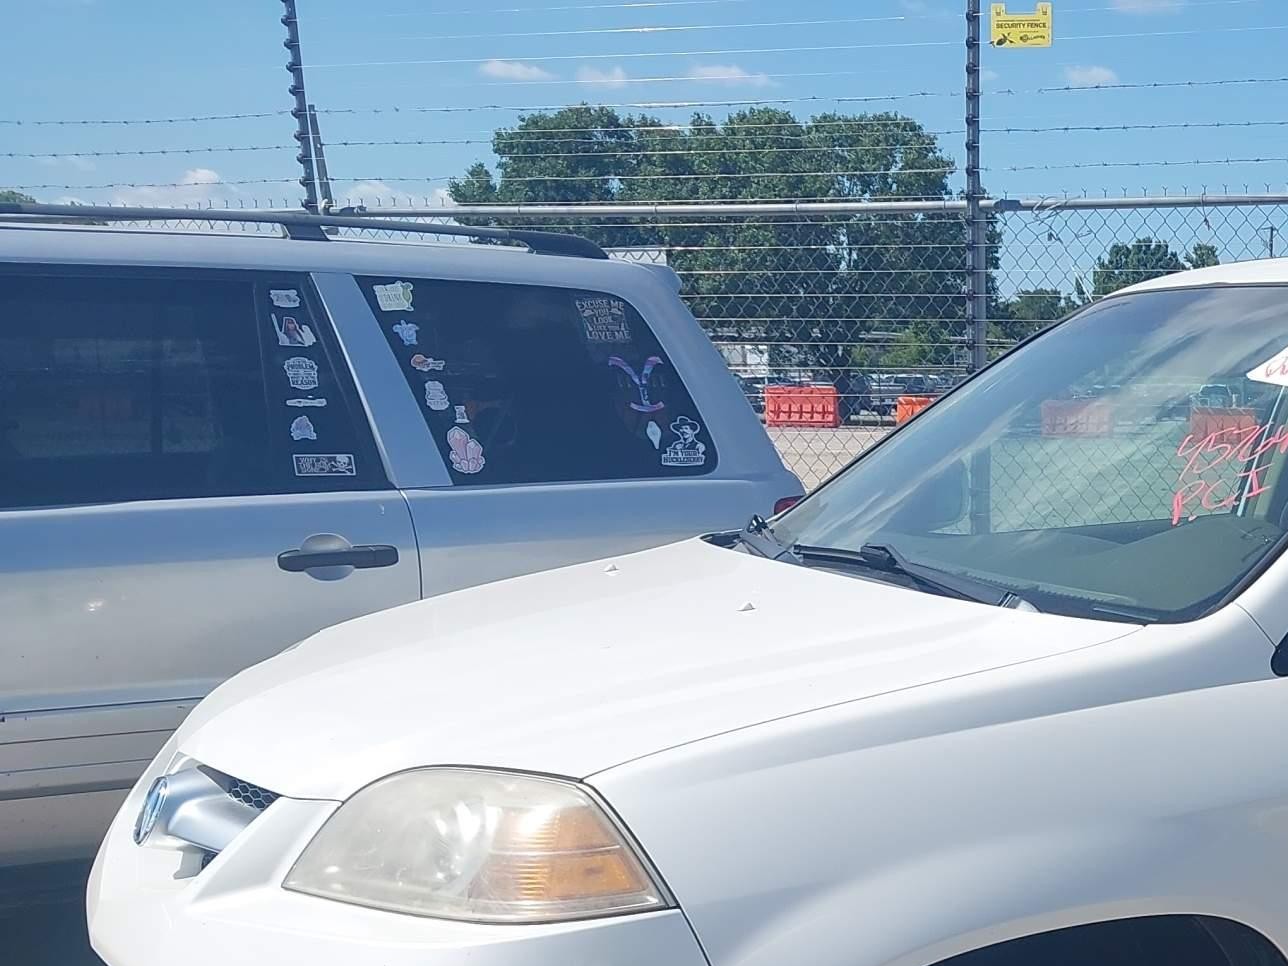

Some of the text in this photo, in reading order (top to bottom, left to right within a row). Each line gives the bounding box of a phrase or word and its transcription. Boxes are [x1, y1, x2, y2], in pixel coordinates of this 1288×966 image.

[576, 299, 625, 310] EXCUSE ME
[586, 331, 632, 340] LOVE ME
